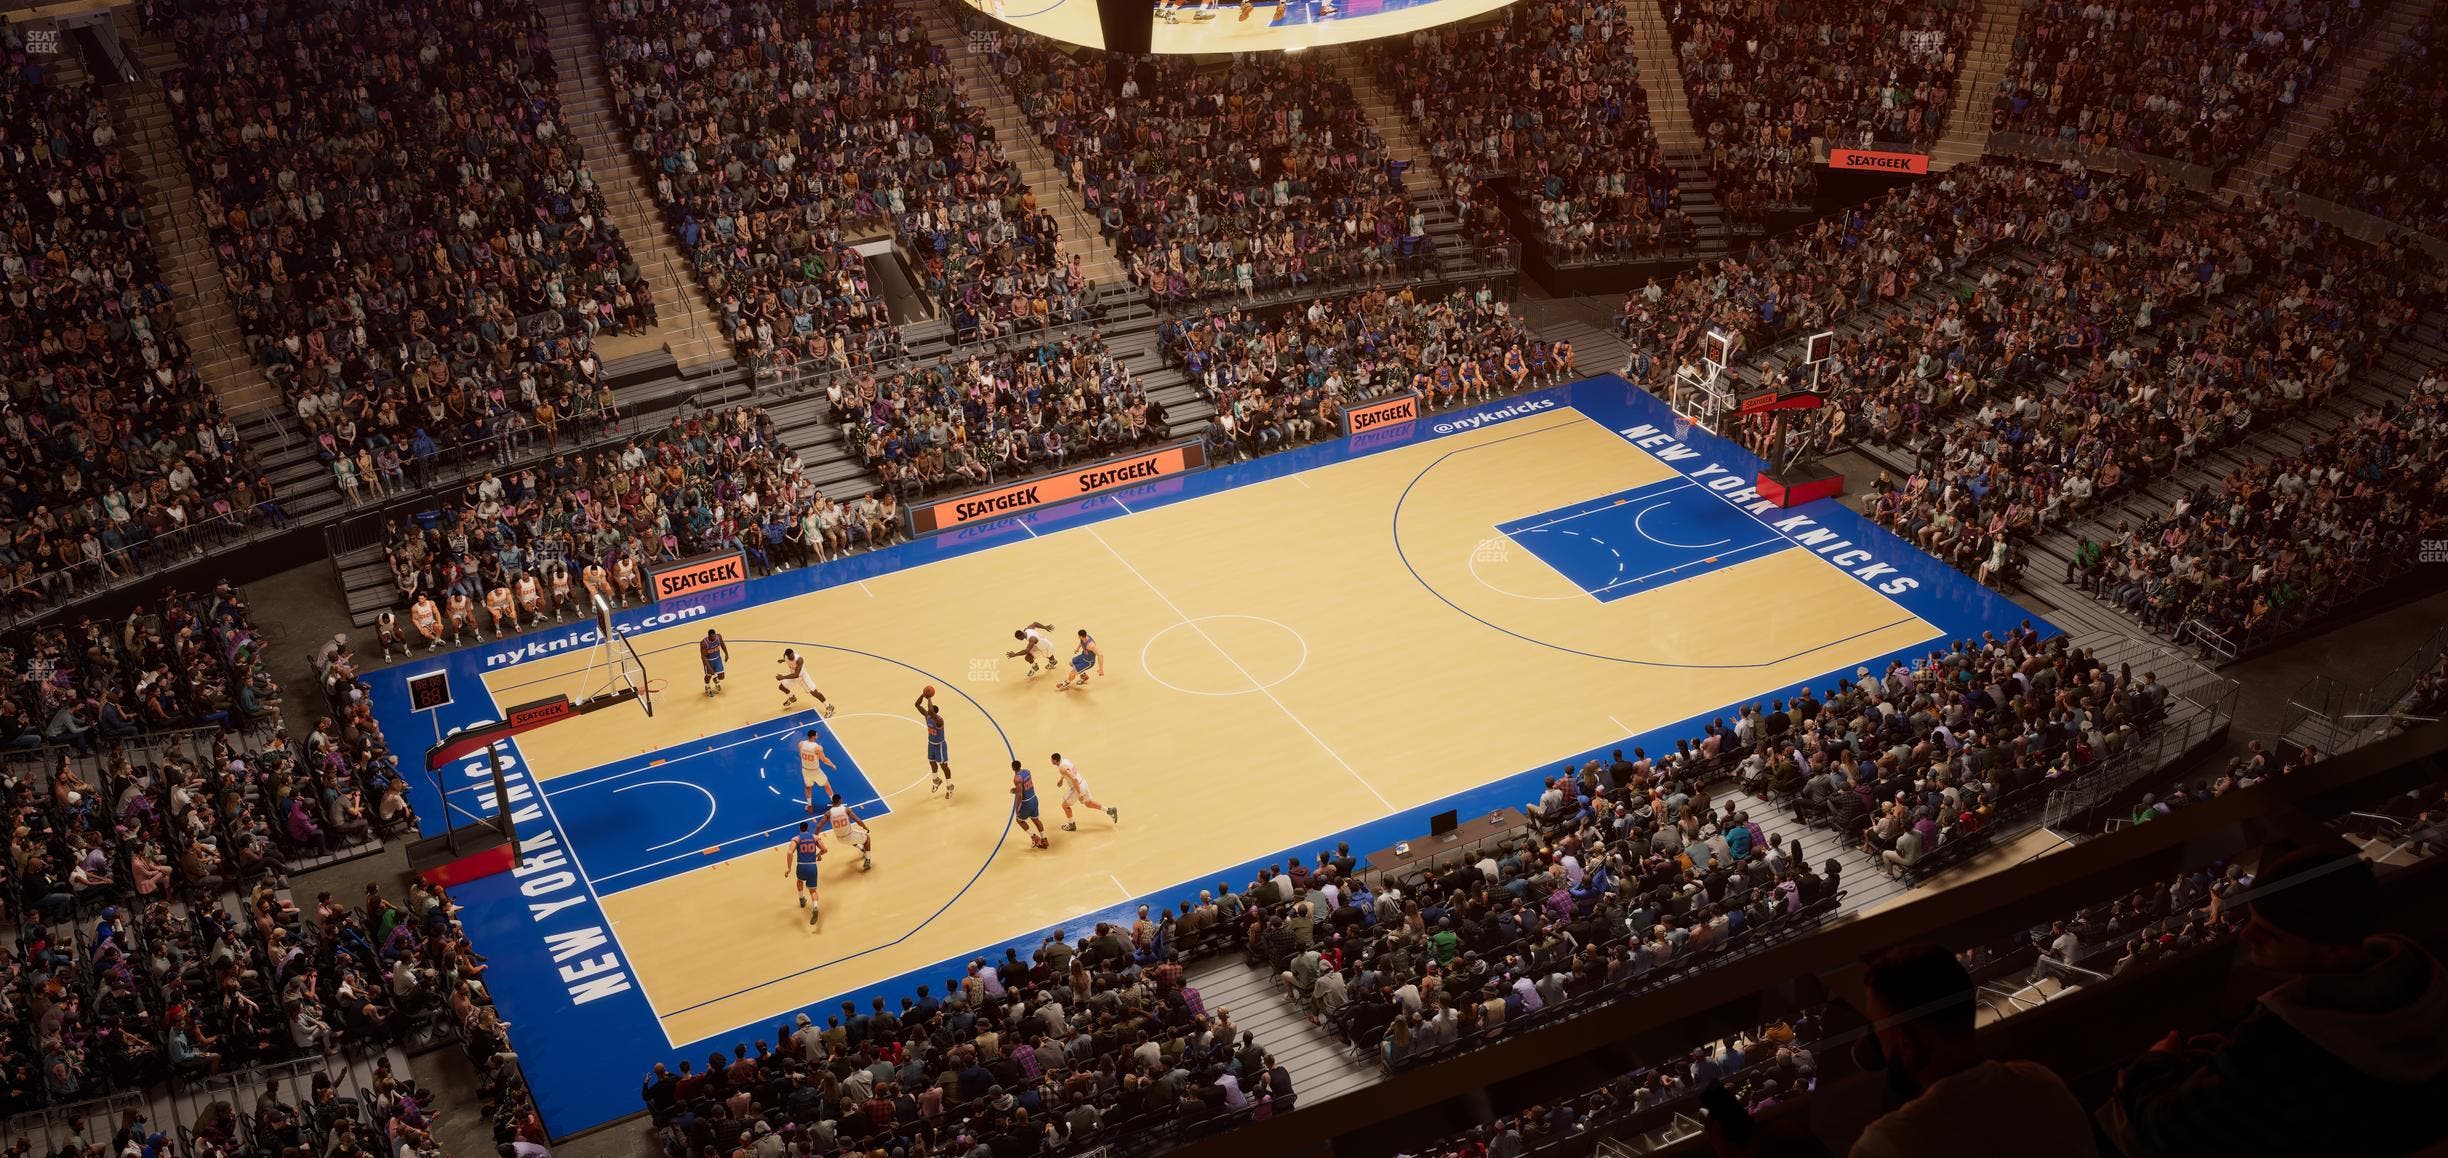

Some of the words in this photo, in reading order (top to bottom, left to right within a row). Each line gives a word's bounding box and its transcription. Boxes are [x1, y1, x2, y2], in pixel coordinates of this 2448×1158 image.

[1847, 154, 1912, 170] SEATGEEK
[1354, 402, 1413, 430] SEATGEEK
[1433, 399, 1555, 434] @nyknicks
[956, 486, 1041, 521] SEATGEEK
[1079, 457, 1160, 492] SEATGEEK
[1620, 423, 1700, 461] NEW
[1690, 463, 1778, 515] YORK
[1772, 514, 1919, 595] KNICKS
[661, 561, 739, 595] SEATGEEK
[486, 605, 707, 669] nyknics.com
[516, 704, 564, 724] SEATGEEK
[832, 818, 848, 829] 00
[799, 842, 816, 853] 00
[511, 829, 587, 922] YORK
[544, 925, 631, 1006] NEW
